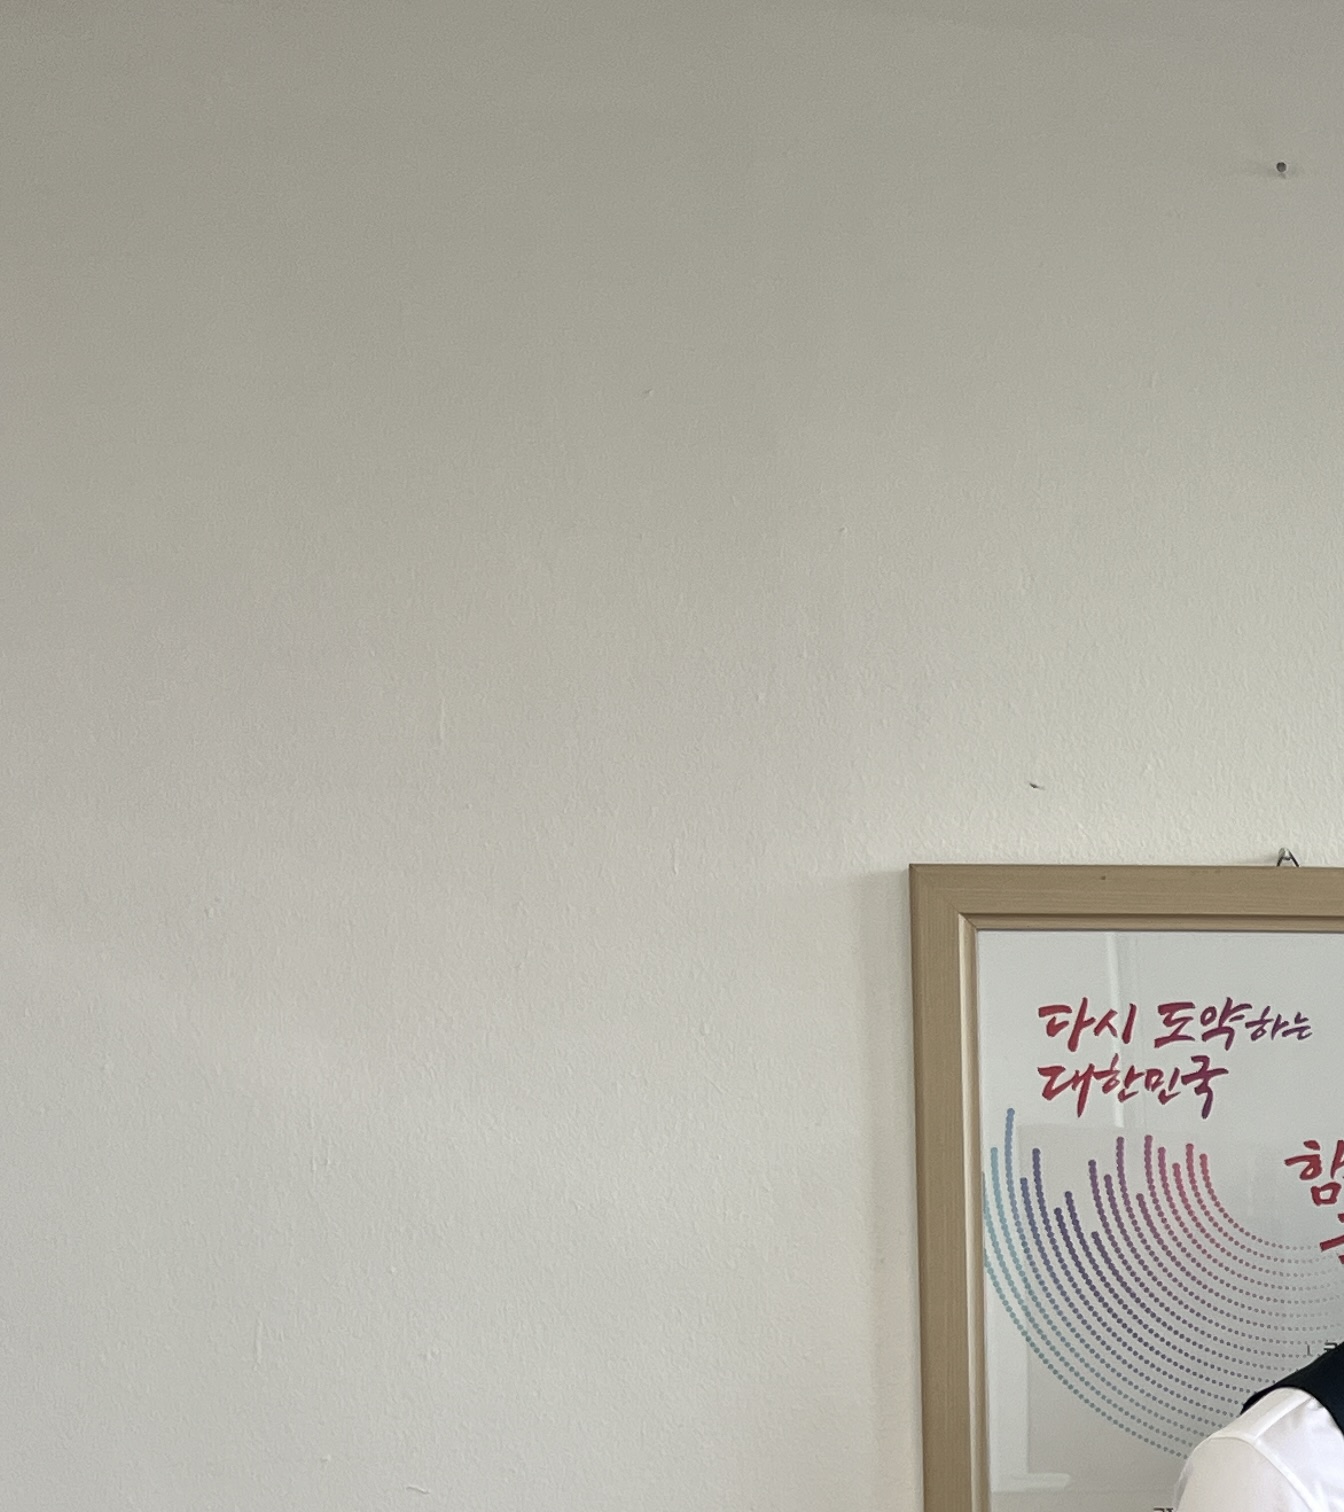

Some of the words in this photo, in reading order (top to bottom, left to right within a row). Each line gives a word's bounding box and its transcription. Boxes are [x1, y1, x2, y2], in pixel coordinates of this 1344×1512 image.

[1038, 997, 1137, 1052] 다시
[1153, 997, 1313, 1051] 도약하는
[1037, 1053, 1229, 1119] 대한민국
